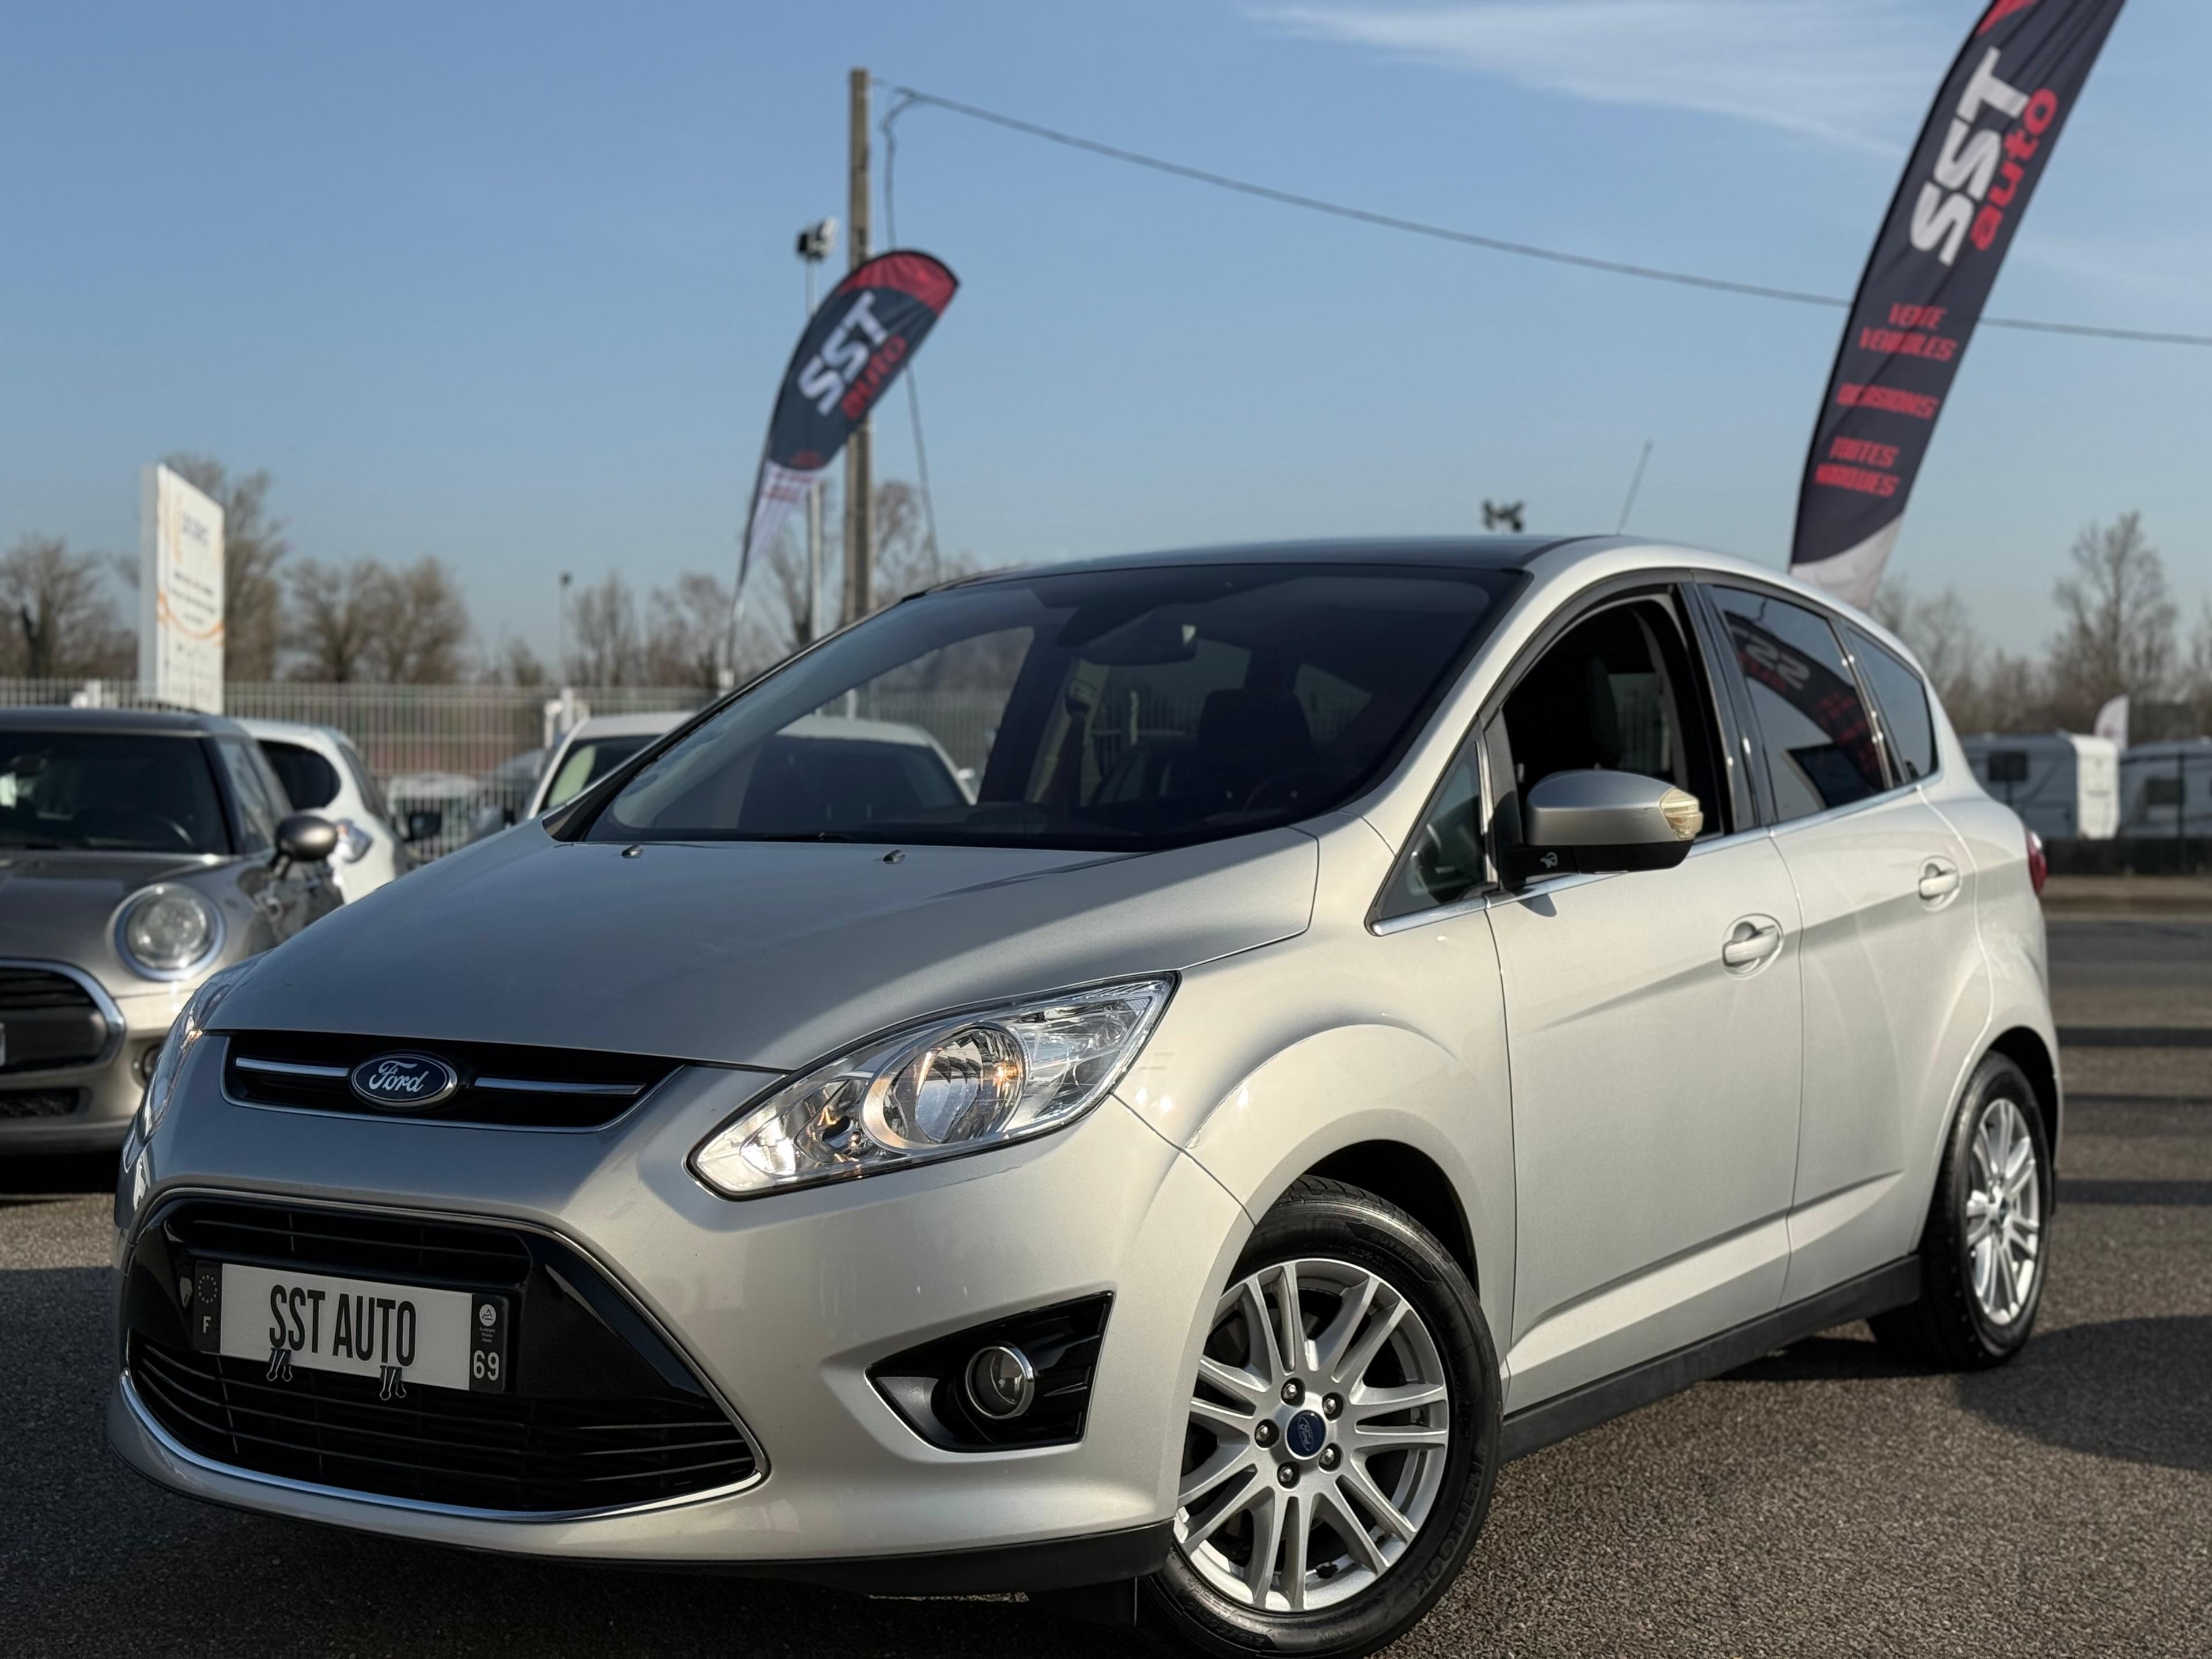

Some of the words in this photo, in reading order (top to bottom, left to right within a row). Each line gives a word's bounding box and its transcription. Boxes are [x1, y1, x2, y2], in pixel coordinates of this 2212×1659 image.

[1909, 46, 2031, 267] SST
[1970, 88, 2058, 252] auto
[798, 290, 888, 415] SST
[369, 1060, 430, 1092] Ford
[202, 1316, 211, 1334] F
[268, 1285, 326, 1353] SST
[332, 1293, 417, 1368] AUTO
[473, 1349, 500, 1381] 69
